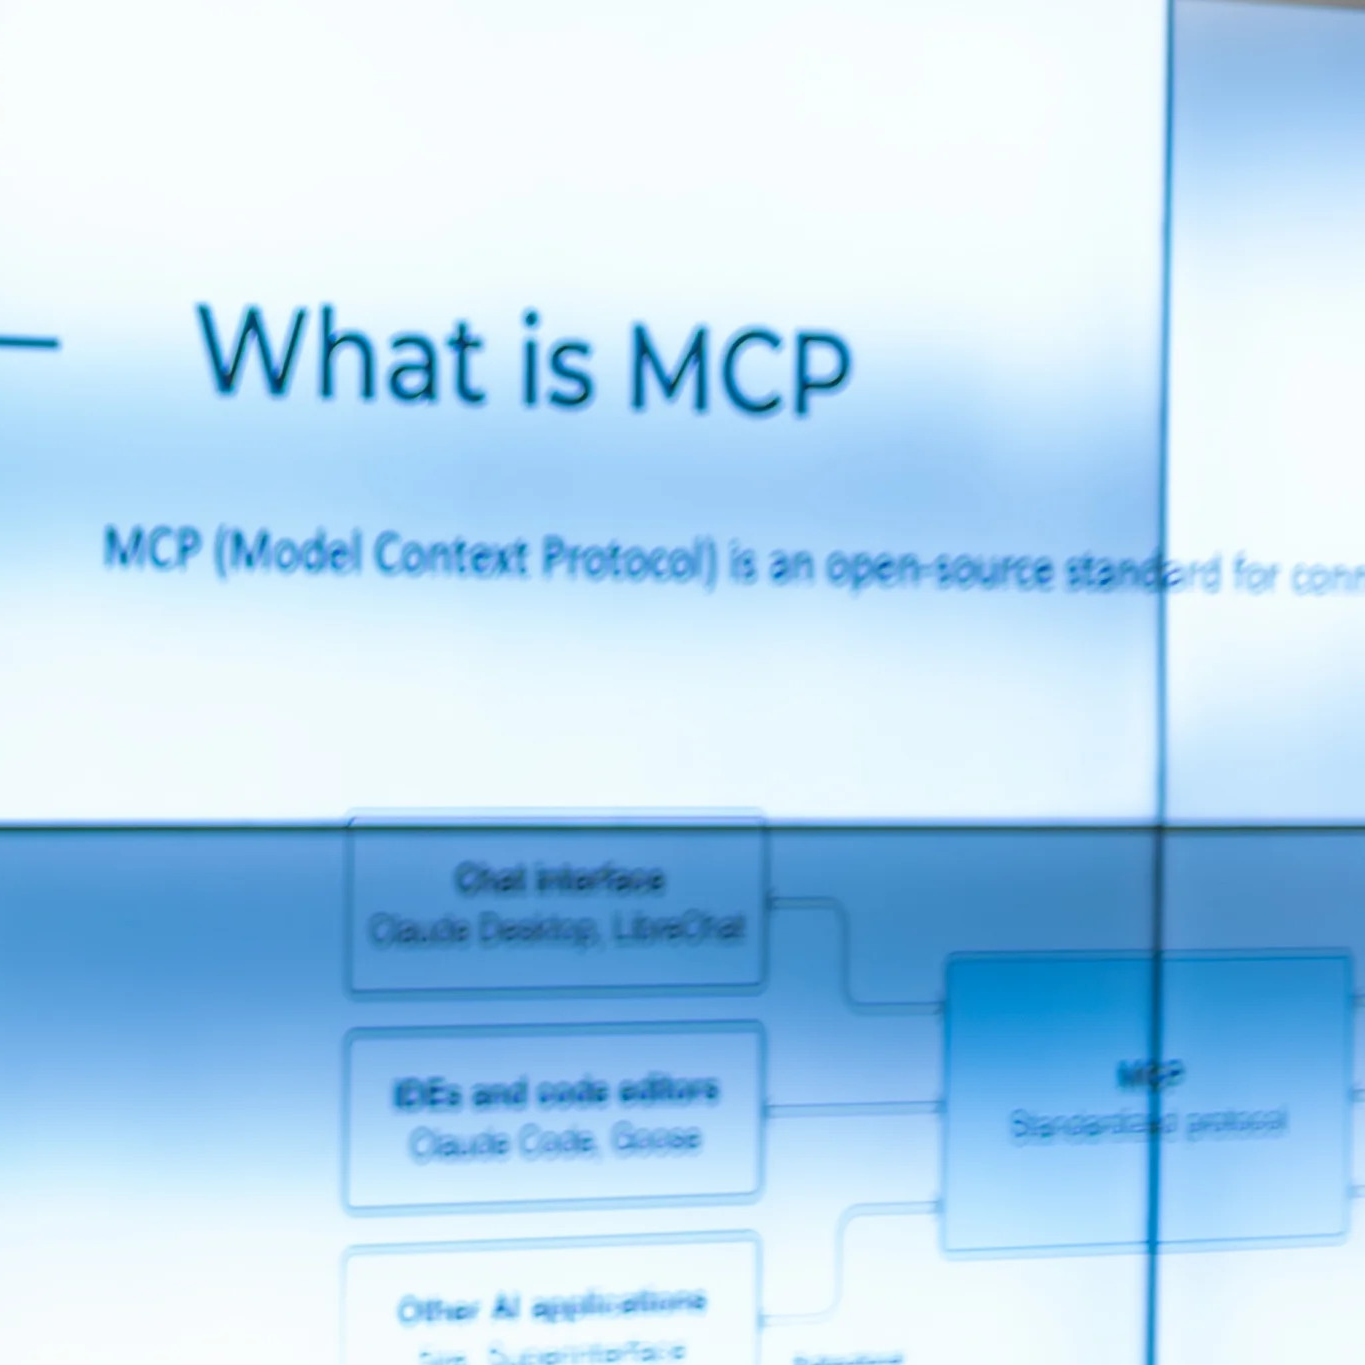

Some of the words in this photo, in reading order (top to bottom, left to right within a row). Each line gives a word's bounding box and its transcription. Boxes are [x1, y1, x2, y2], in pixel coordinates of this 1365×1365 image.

[195, 302, 486, 406] What
[521, 310, 594, 409] is
[631, 321, 852, 419] MCP
[103, 524, 203, 571] MCP
[213, 524, 362, 580] (Model
[373, 532, 527, 580] Context
[543, 534, 719, 594] Protocol)
[730, 540, 757, 584] is
[769, 549, 814, 584] an
[827, 550, 1054, 598] open-source
[1064, 550, 1221, 594] standard
[1234, 551, 1280, 594] for
[535, 862, 665, 894] interface
[392, 1076, 463, 1112] IDEs
[471, 1075, 529, 1110] and
[537, 1074, 610, 1108] code
[618, 1071, 721, 1106] editors
[1118, 1060, 1184, 1095] MP
[409, 1126, 511, 1162] Claude
[610, 1120, 703, 1156] Goose
[397, 1294, 479, 1327] Other
[531, 1287, 709, 1322] applications
